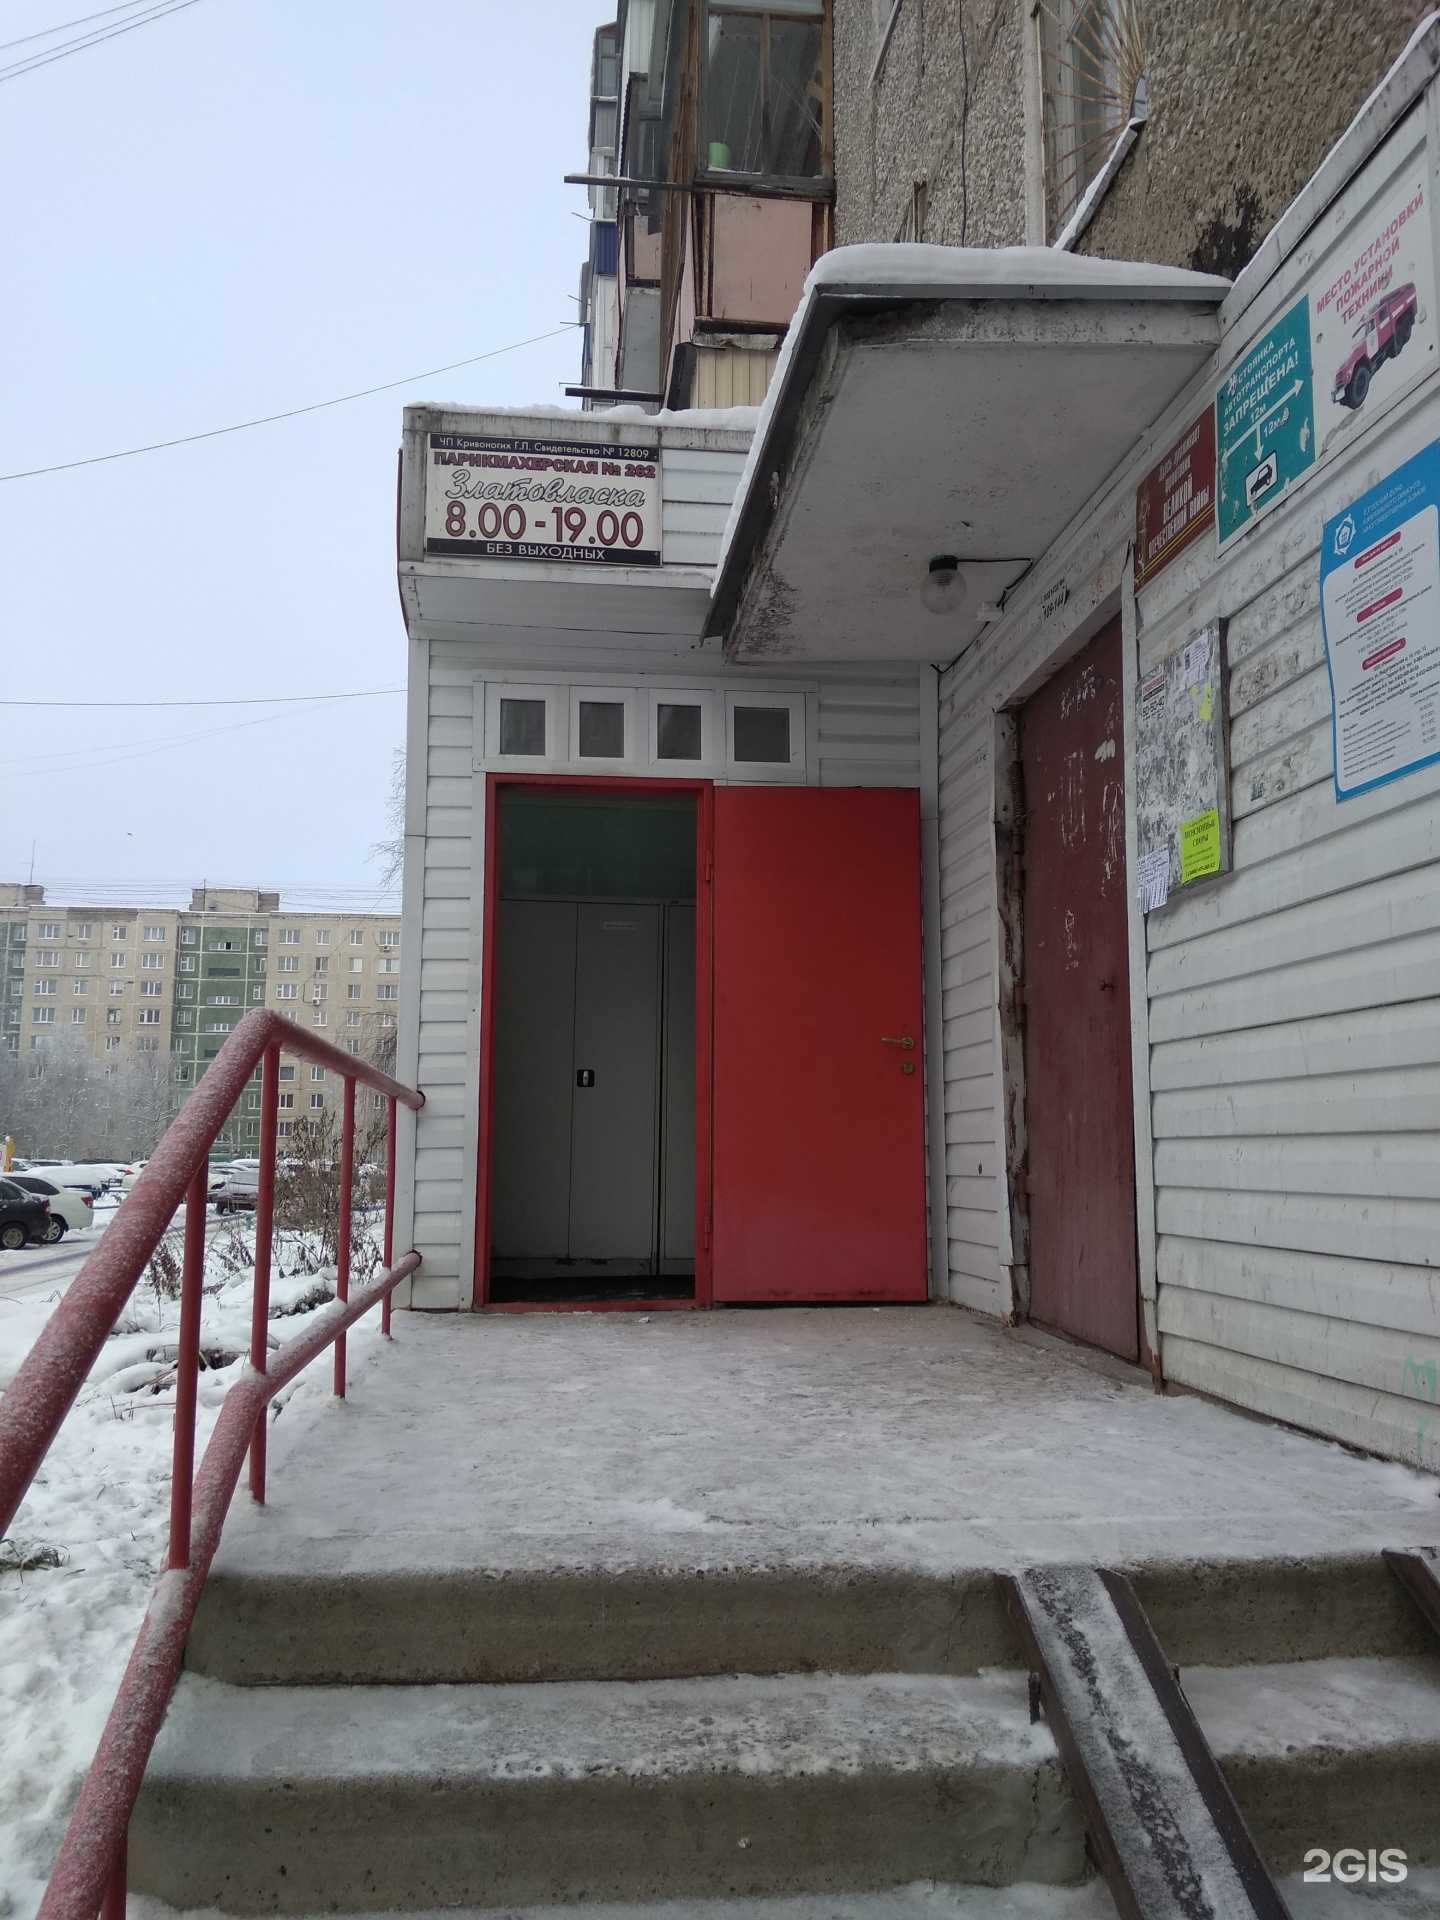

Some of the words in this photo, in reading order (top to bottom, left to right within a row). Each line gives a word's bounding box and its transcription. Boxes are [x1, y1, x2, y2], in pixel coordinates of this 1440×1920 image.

[1317, 270, 1351, 314] МЕСТО
[1353, 192, 1423, 274] УСТАНОВКИ
[1336, 237, 1400, 312] ПОЖАРНОЙ
[1223, 336, 1296, 417] АВТОТРАНСПОРТА
[1238, 340, 1275, 385] СТОЯНКА
[1223, 350, 1299, 438] ЗАПРЕЩЕНА!
[434, 451, 599, 476] ПАРИКМАХЕРСКАЯ
[440, 437, 454, 447] ЧП
[457, 438, 512, 450] Кривоногих
[534, 442, 601, 456] Свидетельство
[619, 447, 649, 459] 12809
[445, 468, 646, 508] Златовласка
[486, 543, 513, 555] БЕЗ
[518, 545, 606, 560] ВЫХОДНЫХ
